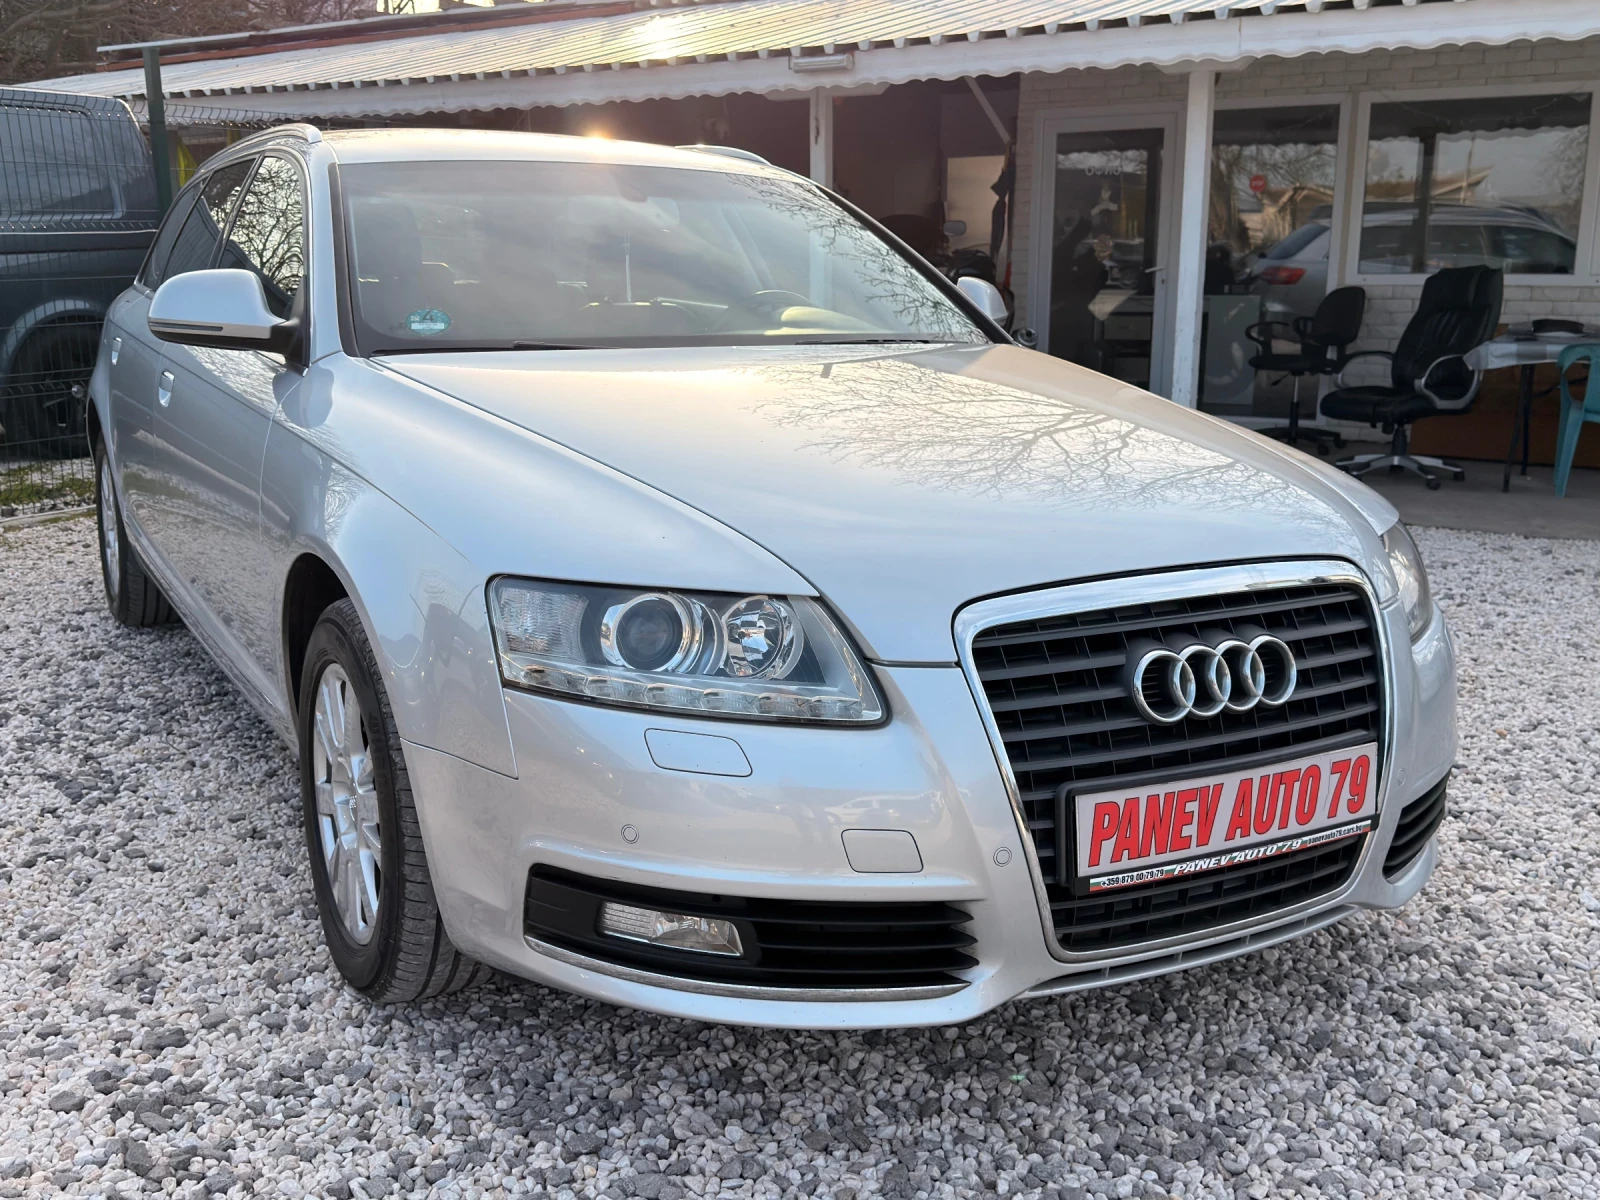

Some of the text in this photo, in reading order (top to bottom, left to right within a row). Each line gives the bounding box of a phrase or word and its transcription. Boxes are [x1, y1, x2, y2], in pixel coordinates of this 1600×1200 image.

[422, 310, 435, 321] 4
[1088, 754, 1371, 868] PANEV AUTO 79
[1101, 876, 1120, 888] +359
[1121, 874, 1134, 884] 879
[1145, 870, 1155, 880] 79
[1156, 868, 1164, 878] 79
[1173, 854, 1234, 875] PANEV
[1233, 843, 1279, 864] AUTO
[1281, 838, 1303, 853] 79
